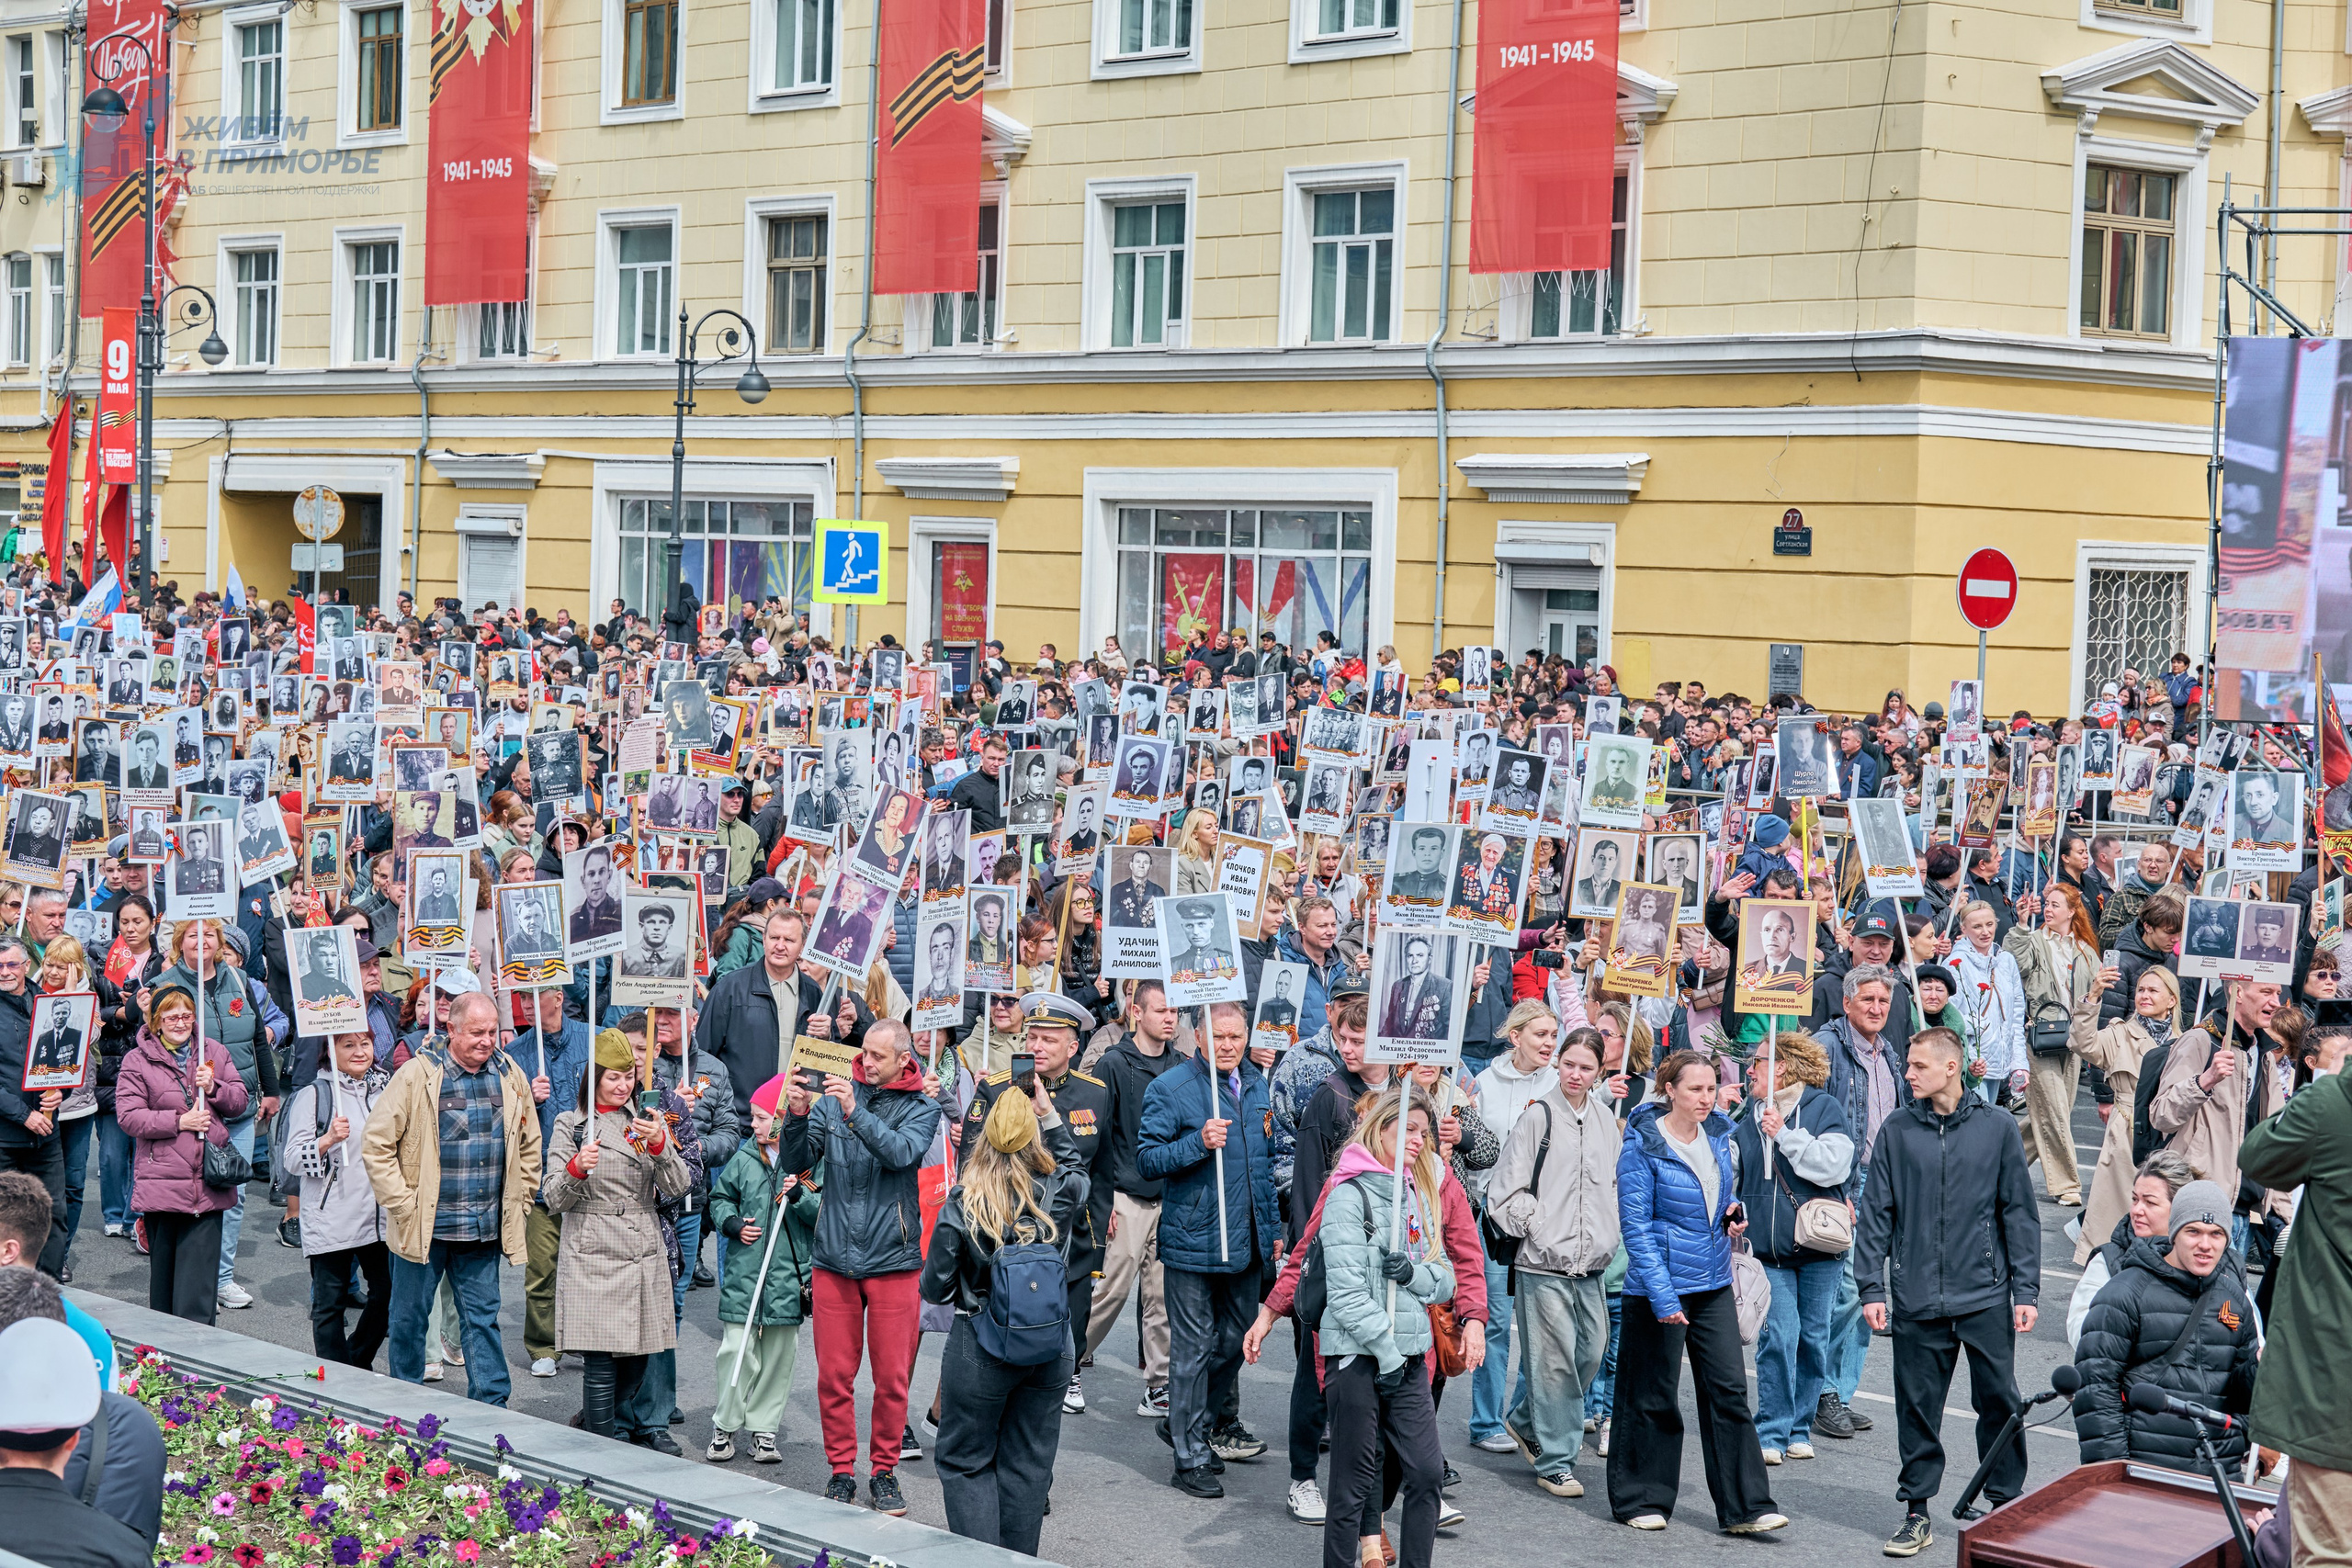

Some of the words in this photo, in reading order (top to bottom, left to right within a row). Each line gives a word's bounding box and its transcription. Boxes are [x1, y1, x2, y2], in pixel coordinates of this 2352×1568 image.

[1500, 39, 1594, 68] 1941-1945
[443, 157, 513, 182] 1941-1945
[108, 340, 129, 380] 9
[107, 382, 129, 394] МАЯ
[106, 459, 132, 468] ПОБЕДЫ!
[1786, 513, 1800, 528] 27
[18, 853, 50, 865] Величко
[1227, 862, 1256, 874] КЛОЧКОВ
[850, 863, 869, 875] Клавдия
[870, 872, 899, 890] Михайловна
[1230, 874, 1248, 884] ИВАН
[1221, 883, 1256, 897] ИВАНОВИЧ
[1237, 908, 1250, 918] 1943
[1466, 924, 1511, 936] Константиновна
[586, 937, 607, 947] Морозов
[1118, 937, 1159, 947] УДАЧИН
[571, 947, 592, 958] Василий
[807, 948, 837, 967] Зарипов
[838, 961, 864, 976] Ханиф
[1616, 976, 1653, 986] ГОНЧАРЕНКО
[1630, 984, 1659, 992] Григорьевич
[1391, 1038, 1436, 1046] Емельяненко
[805, 1048, 854, 1065] Владивосток
